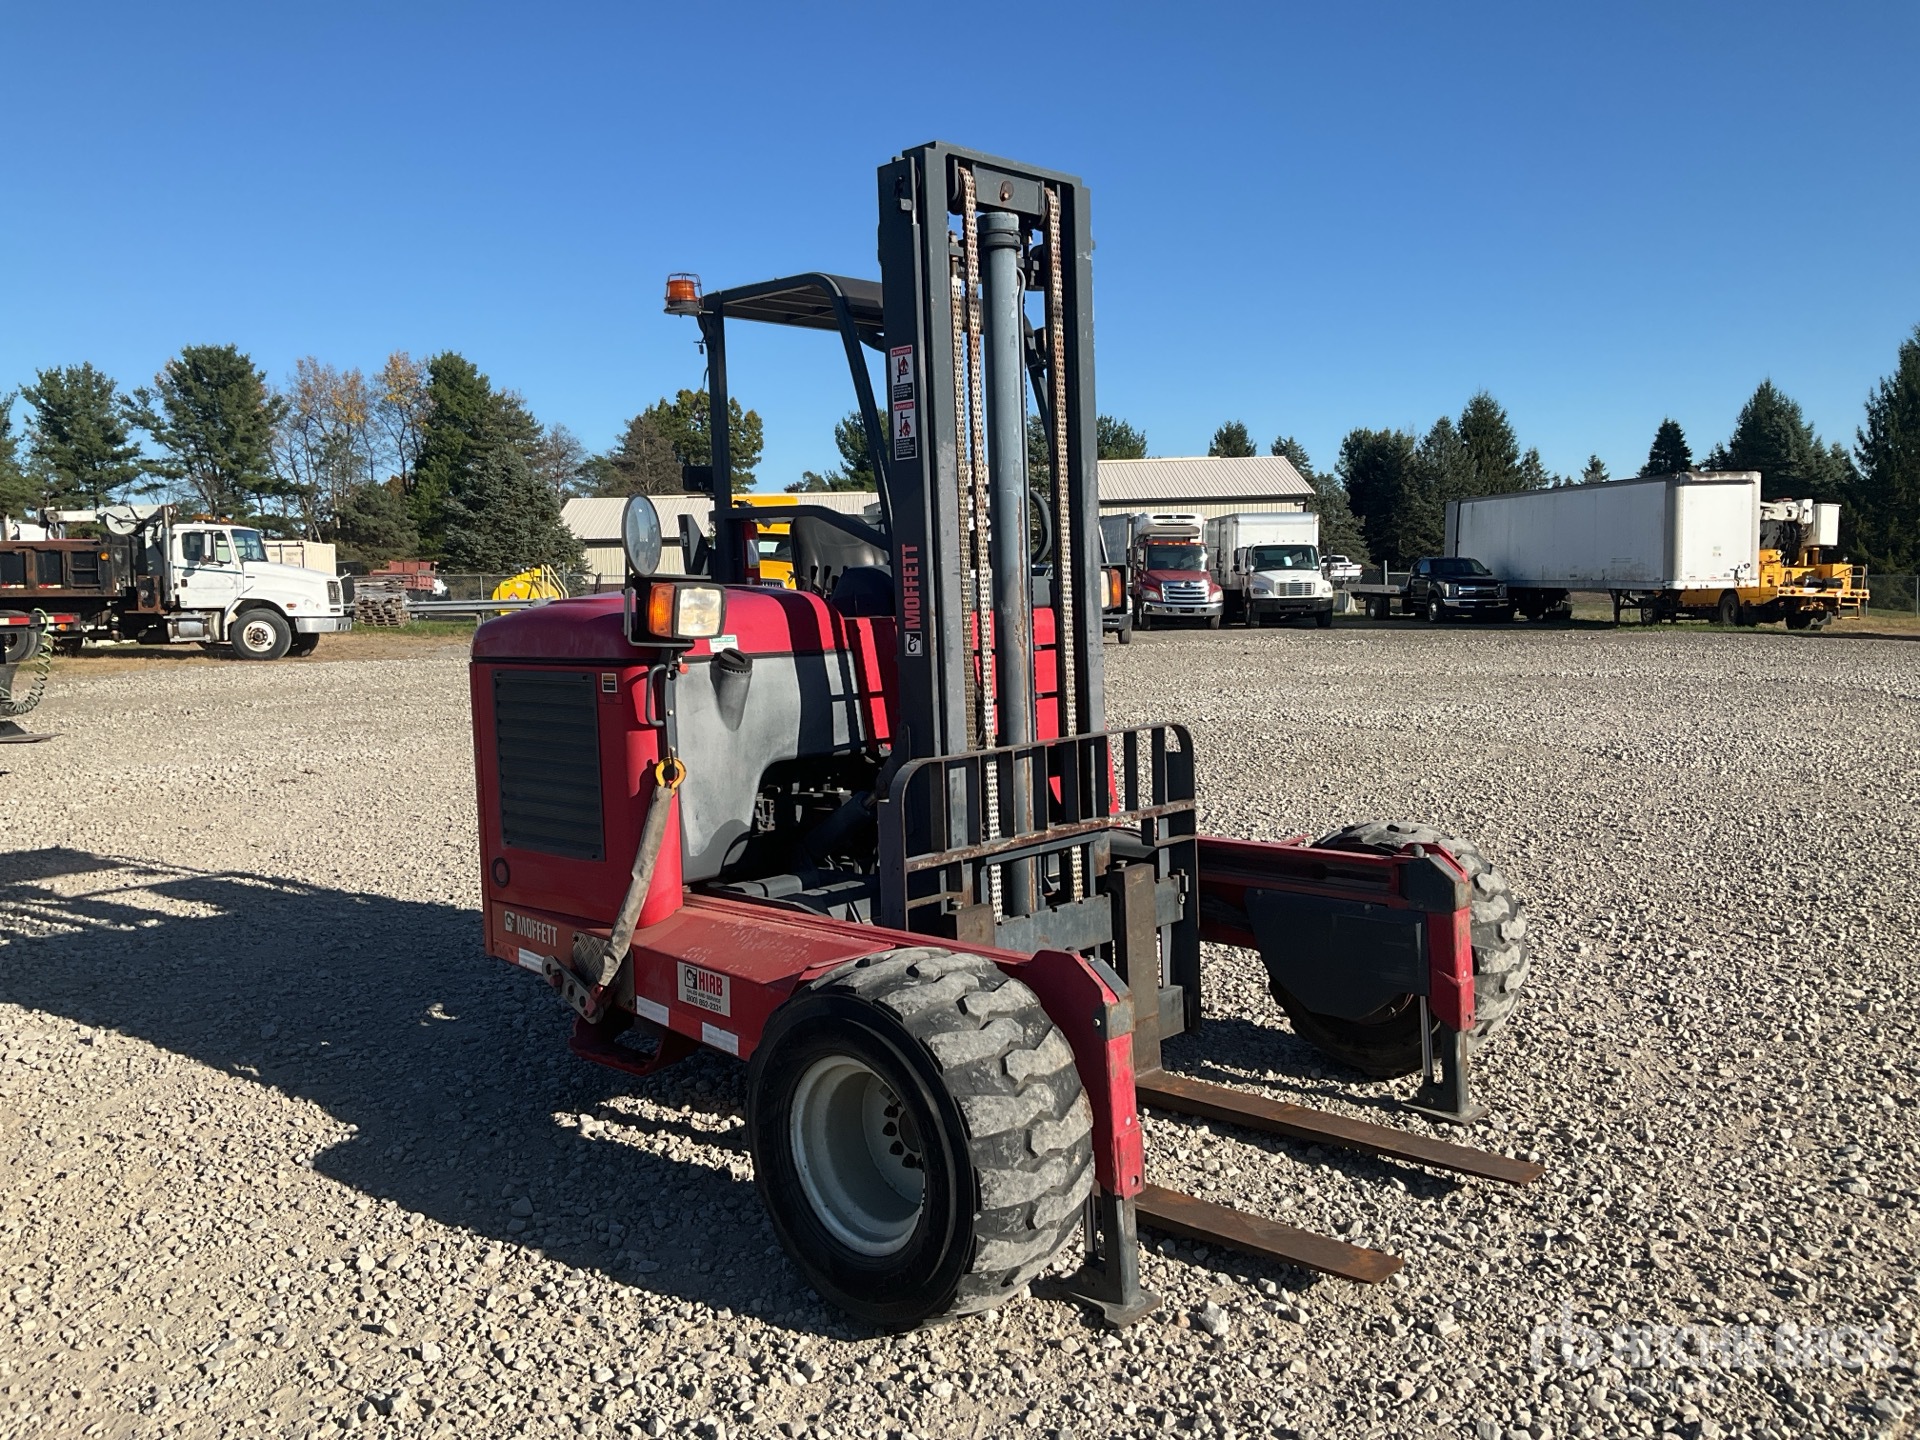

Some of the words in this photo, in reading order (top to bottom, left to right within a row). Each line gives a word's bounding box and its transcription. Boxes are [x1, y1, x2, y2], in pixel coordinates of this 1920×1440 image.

[902, 544, 921, 629] MOFFETT
[516, 914, 558, 947] MOFFETT
[698, 970, 723, 997] HIAB
